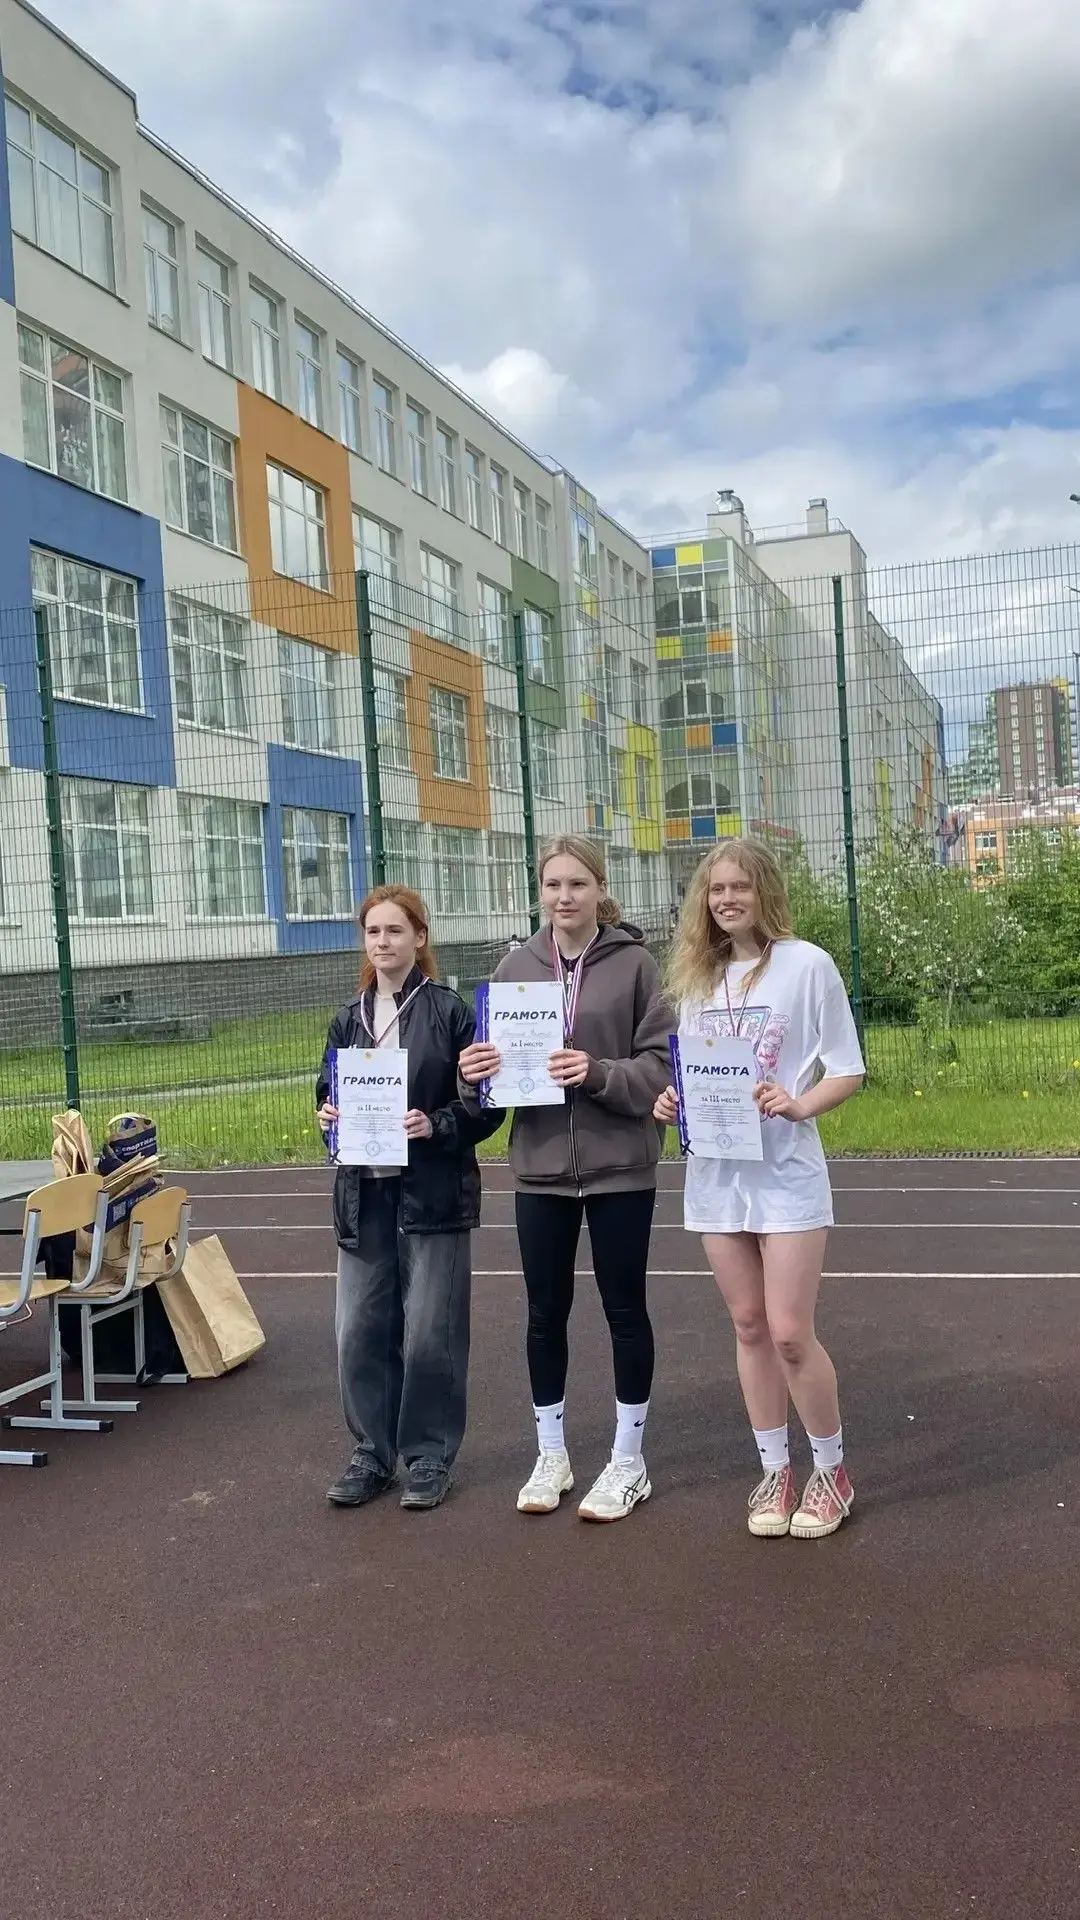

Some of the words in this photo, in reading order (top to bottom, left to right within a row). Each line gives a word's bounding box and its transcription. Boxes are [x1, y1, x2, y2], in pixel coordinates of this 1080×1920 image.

[494, 1011, 557, 1020] ГРАМОТА
[686, 1064, 750, 1076] ГРАМОТА
[342, 1076, 402, 1086] ГРАМОТА
